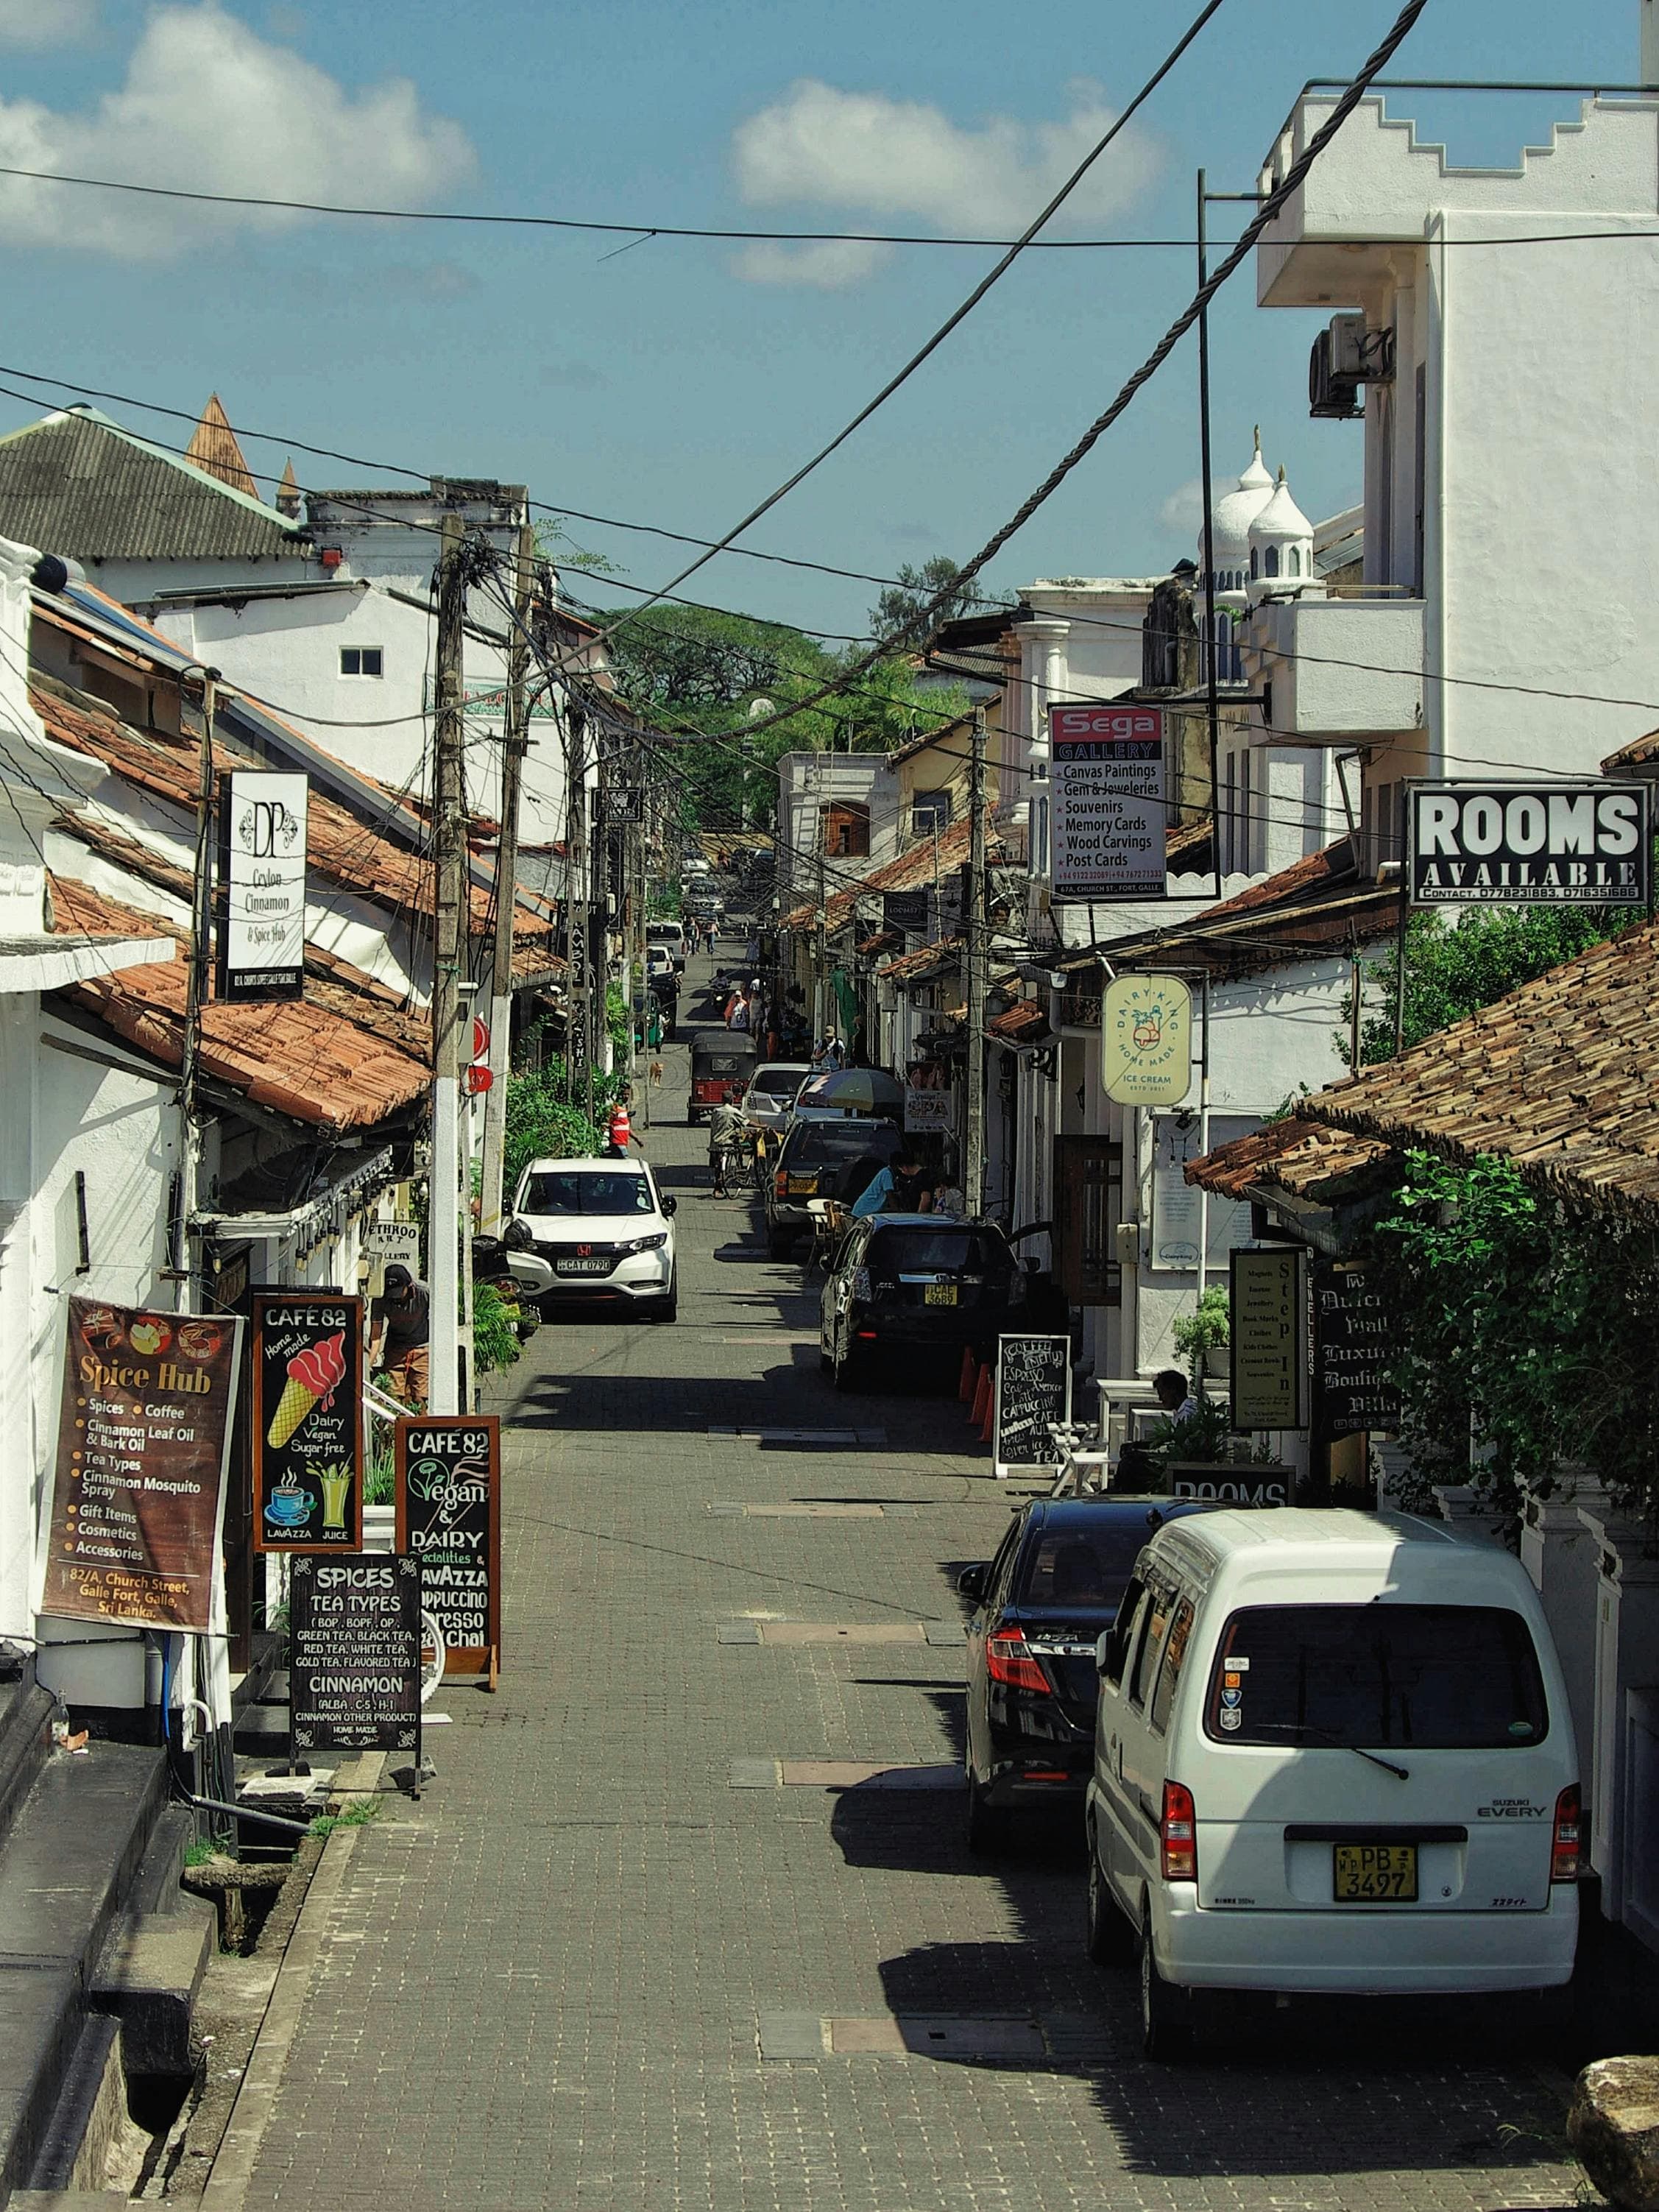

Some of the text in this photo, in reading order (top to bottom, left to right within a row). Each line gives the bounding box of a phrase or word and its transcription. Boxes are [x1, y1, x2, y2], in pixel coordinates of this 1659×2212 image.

[1061, 713, 1155, 739] Sega
[1058, 743, 1153, 759] GALLERY
[1064, 763, 1156, 781] Canvas Paintings
[1064, 782, 1089, 796] Gem
[1092, 782, 1100, 796] &
[1065, 799, 1123, 814] Souvenirs
[1066, 816, 1147, 835] Memory Cards
[1419, 795, 1638, 855] ROOMS
[1067, 835, 1152, 851] Wood Carvings
[1066, 852, 1128, 867] Post Cards
[253, 868, 281, 890] Ceylon
[1423, 862, 1636, 886] AVAILABLE
[245, 893, 289, 913] Cinnamon
[254, 926, 270, 946] Spice
[271, 922, 286, 944] Hub
[1117, 989, 1178, 1031] DAIRY KING
[1119, 1043, 1175, 1066] HOME MADE
[1141, 1075, 1171, 1084] CREAM
[378, 1235, 403, 1244] ART
[567, 1260, 584, 1269] CAT
[266, 1304, 347, 1326] CAFÉ 82
[1306, 1277, 1315, 1376] EWELLERS
[265, 1332, 291, 1360] Home
[283, 1331, 311, 1357] made
[79, 1355, 212, 1394] Spice Hub
[1004, 1365, 1044, 1382] ESPRESSO
[89, 1398, 185, 1419] Spices Coffee
[88, 1419, 194, 1442] Cinnamon Leaf Oil
[309, 1413, 344, 1431] Dairy
[86, 1432, 146, 1452] & Bark Oil
[303, 1427, 337, 1446] Vegan
[408, 1428, 489, 1455] CAFÉ 82
[291, 1440, 345, 1458] Sugar free
[1033, 1449, 1059, 1463] TEA
[85, 1452, 141, 1472] Tea Types
[81, 1482, 116, 1499] Spray
[82, 1469, 201, 1495] Cinnamon Mosquito
[79, 1504, 137, 1524] Gift Items
[439, 1510, 453, 1524] &
[78, 1522, 137, 1541] Cosmetics
[267, 1527, 312, 1539] LAVAZZA
[322, 1530, 349, 1541] JUICE
[411, 1531, 484, 1548] DAIRY
[76, 1541, 144, 1561] Accessories
[422, 1550, 471, 1563] ecialities
[70, 1568, 190, 1595] 82/A, Church Street,
[316, 1567, 395, 1589] SPICES
[421, 1565, 489, 1586] AVAZZA
[79, 1584, 177, 1608] Galle Fort, Galle,
[311, 1595, 402, 1613] TEA TYPES
[422, 1589, 488, 1609] ppuccino
[98, 1600, 156, 1619] Sri Lanka.
[297, 1630, 330, 1641] GREEN
[357, 1630, 390, 1641] BLACK
[446, 1629, 484, 1647] Chai
[303, 1644, 324, 1654] RED
[350, 1644, 383, 1654] WHITE
[296, 1657, 319, 1667] GOLD
[344, 1657, 390, 1667] FLAVORED
[309, 1676, 403, 1693] CINNAMON
[295, 1712, 342, 1722] CINNAMON
[343, 1712, 372, 1722] OTHER
[1478, 1806, 1547, 1817] EVERY
[1361, 1848, 1390, 1870] PB
[1347, 1873, 1405, 1895] 3497
